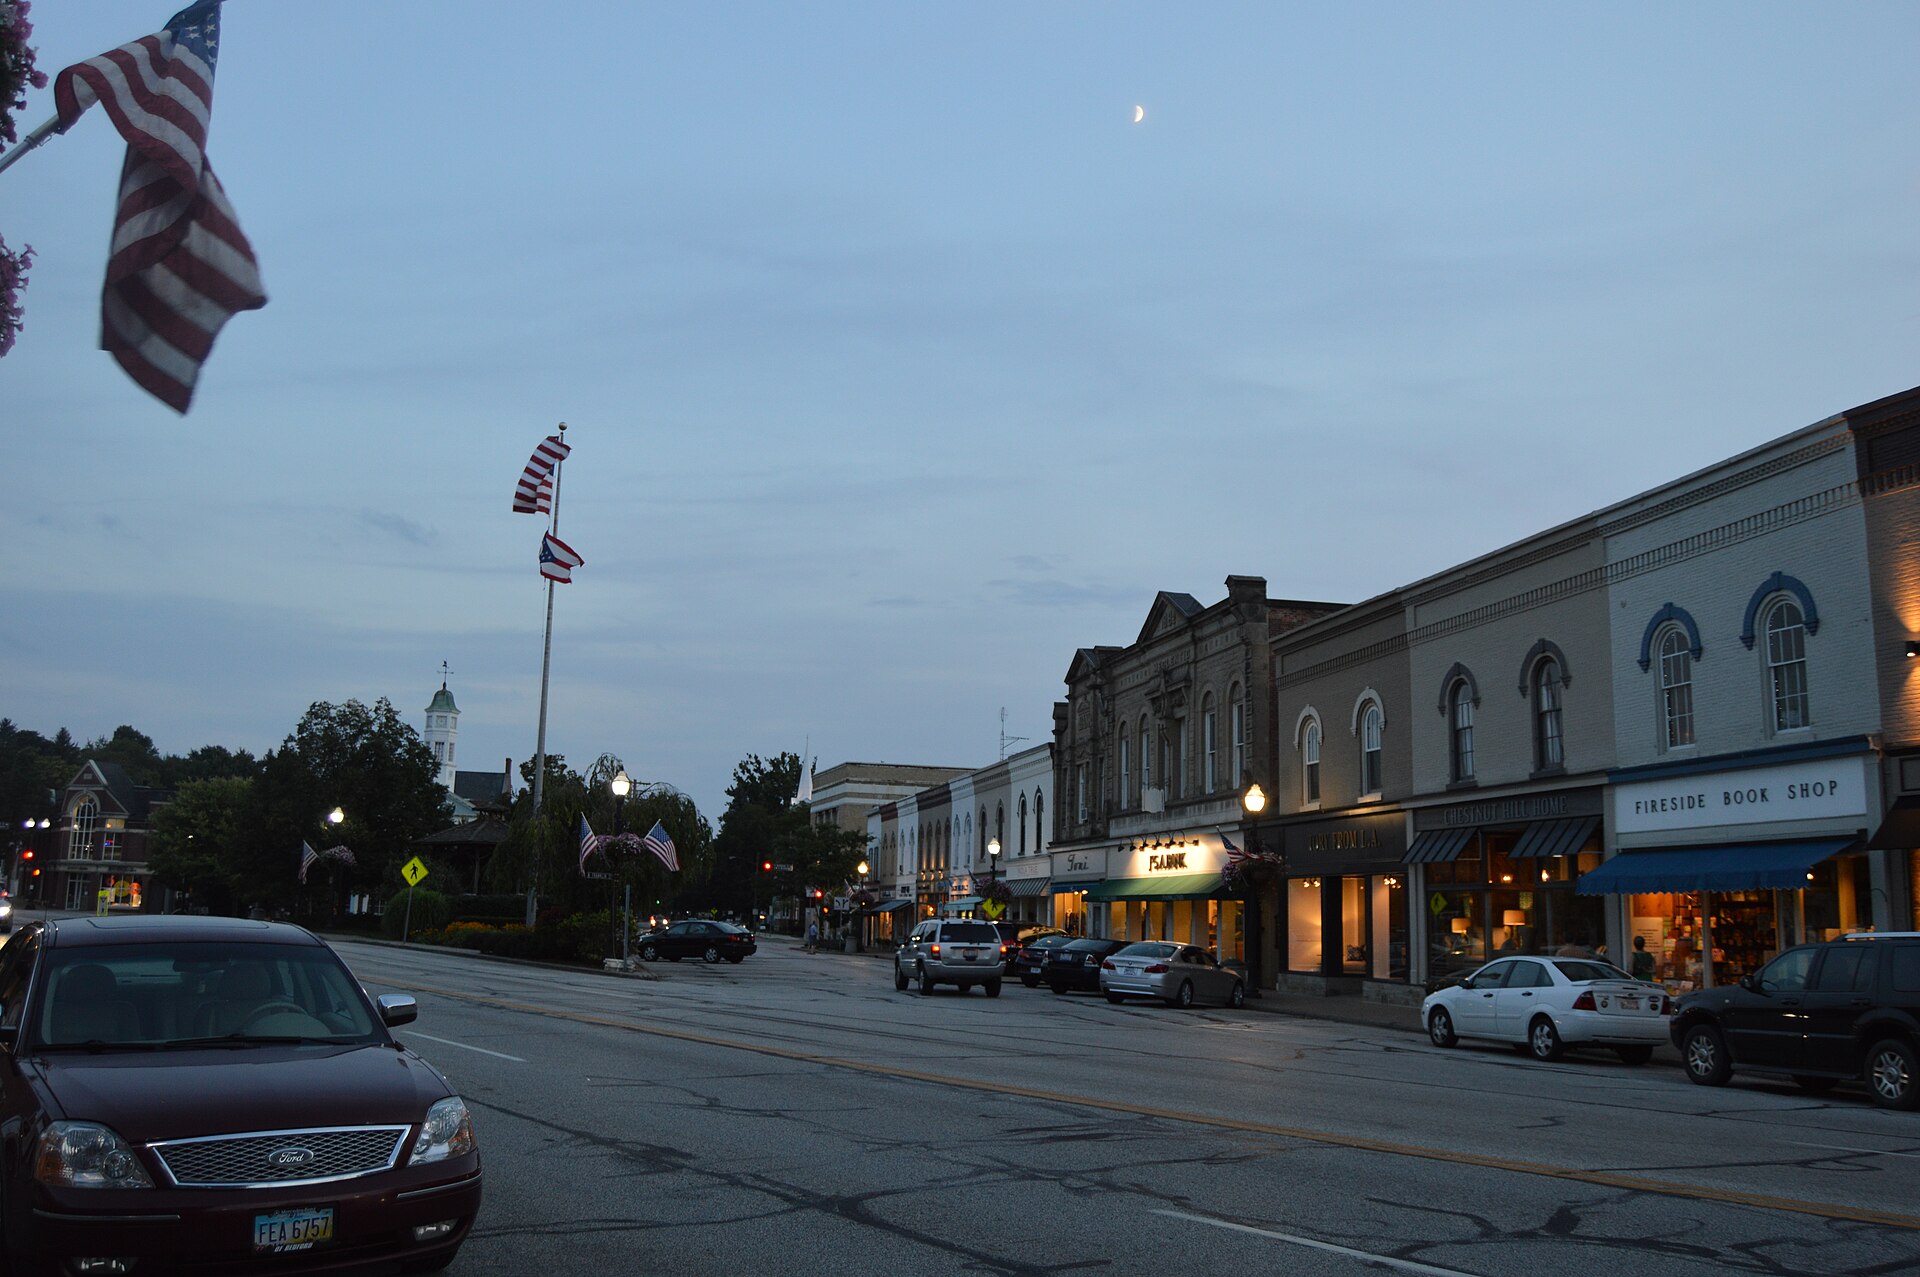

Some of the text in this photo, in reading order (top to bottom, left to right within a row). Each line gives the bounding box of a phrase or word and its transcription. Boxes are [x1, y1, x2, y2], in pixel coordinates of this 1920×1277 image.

[1443, 796, 1567, 825] CHESTNUT HILL HOME
[1635, 780, 1838, 815] FIRESIDE BOOK SHOP
[279, 1151, 304, 1163] Ford
[259, 1216, 329, 1243] FEA 6757
